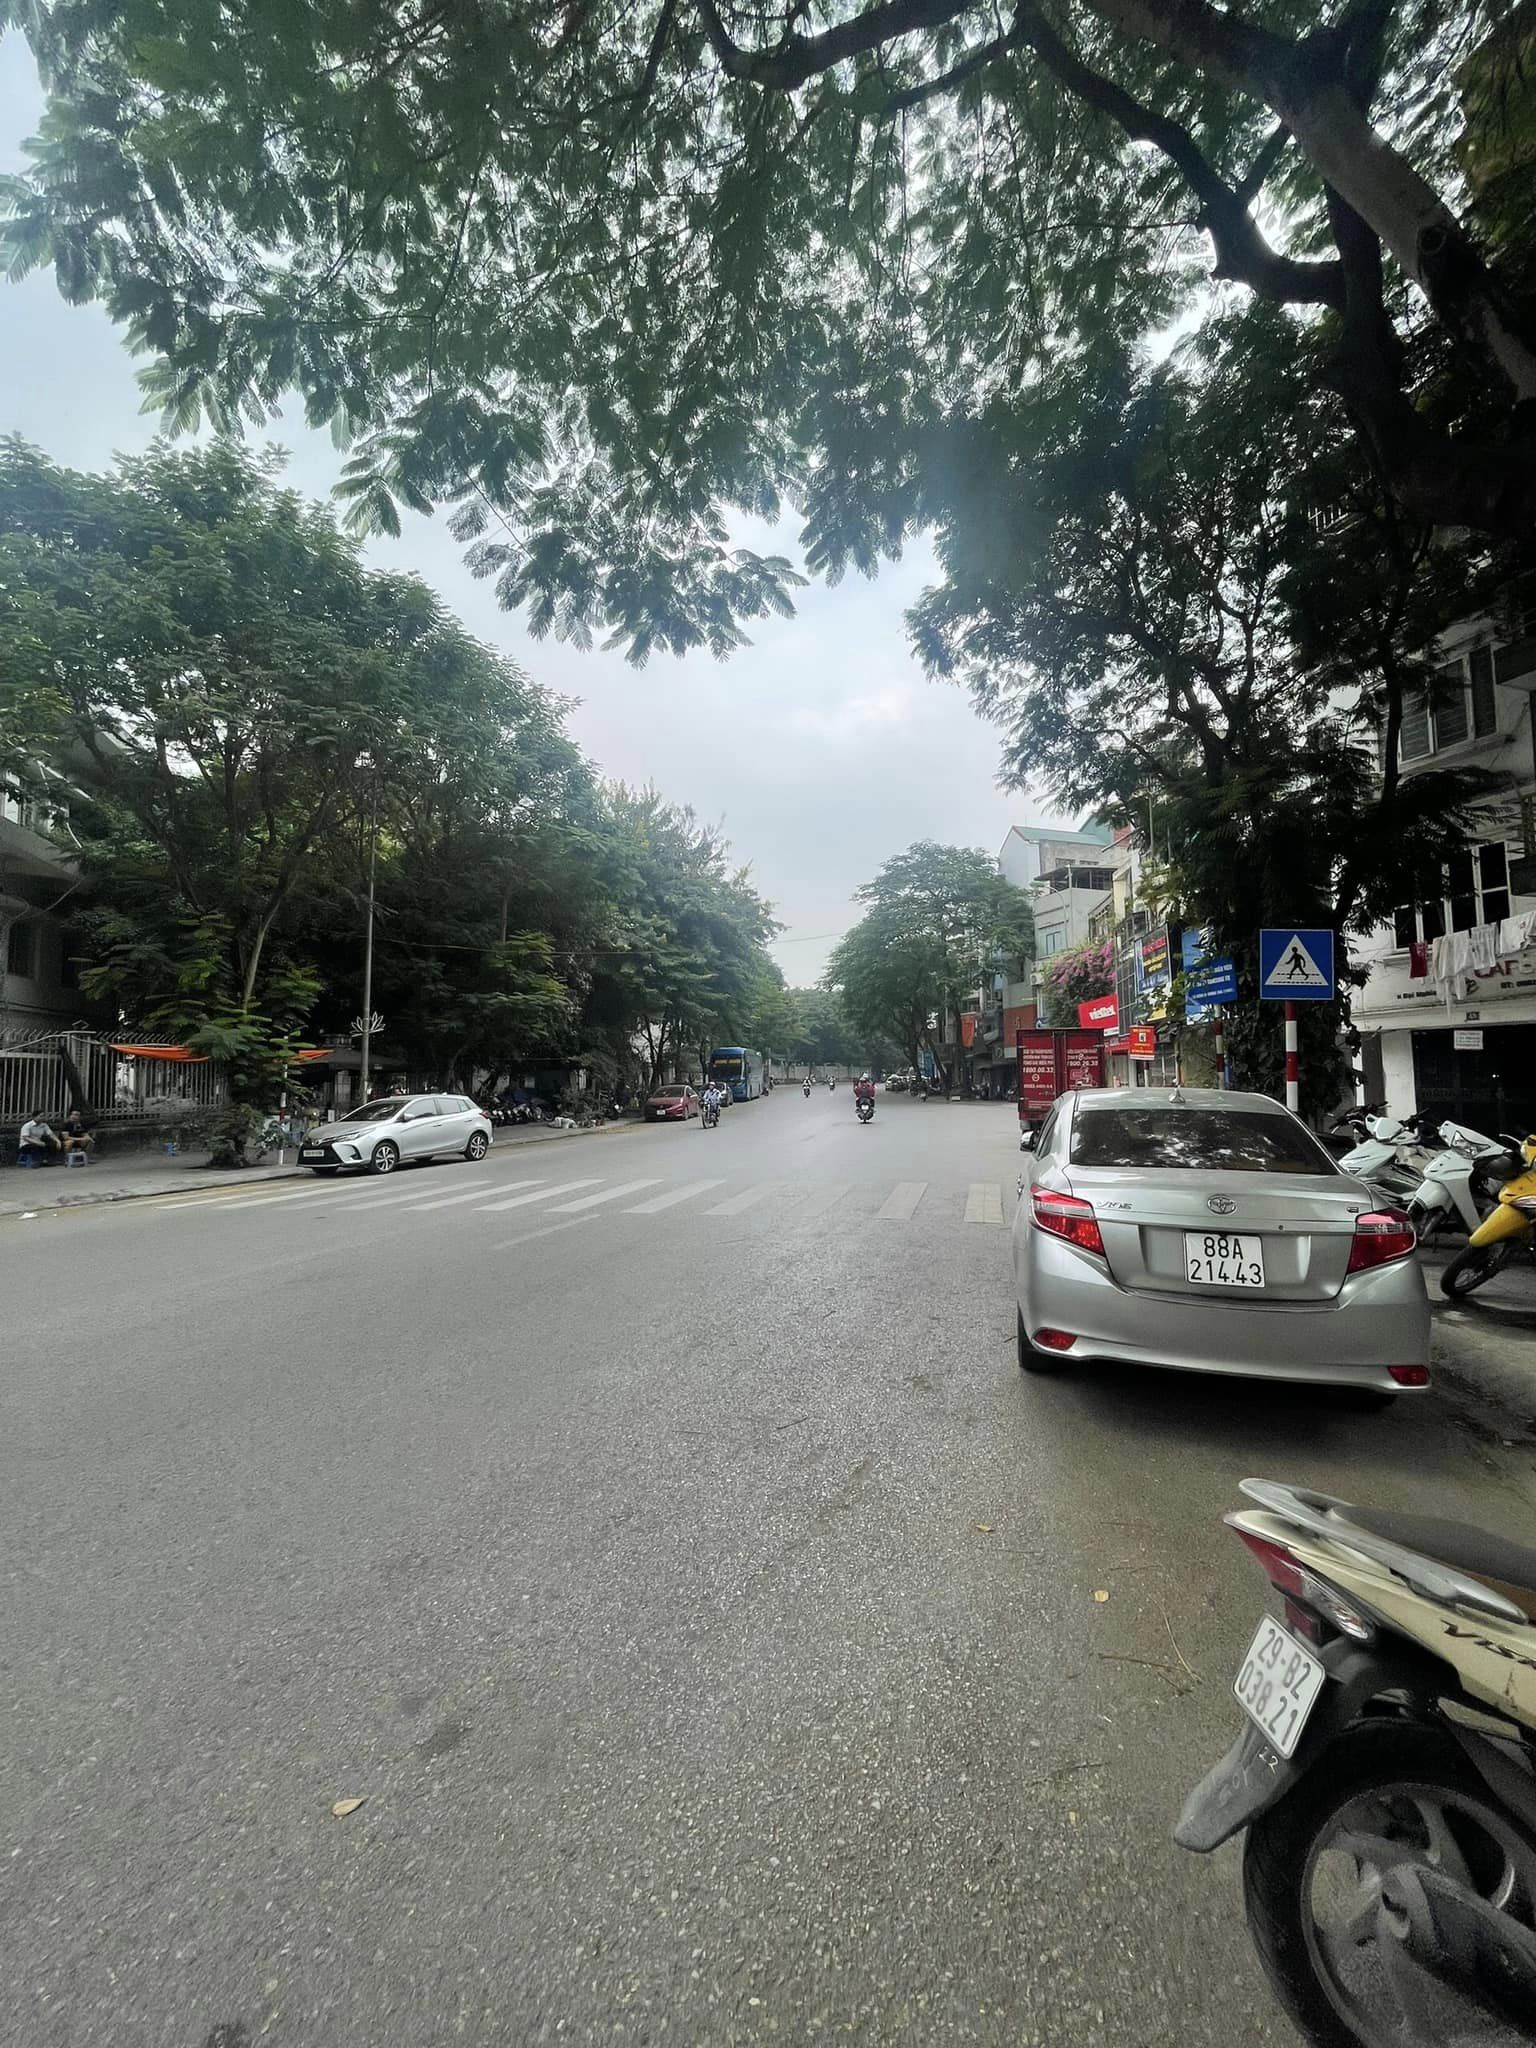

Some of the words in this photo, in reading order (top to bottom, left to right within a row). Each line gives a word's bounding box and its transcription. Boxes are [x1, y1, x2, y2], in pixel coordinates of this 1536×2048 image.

[1190, 1260, 1263, 1285] 214.43
[1204, 1237, 1244, 1260] 88A
[1258, 1628, 1312, 1700] 29-B2
[1238, 1660, 1298, 1746] 038.21
